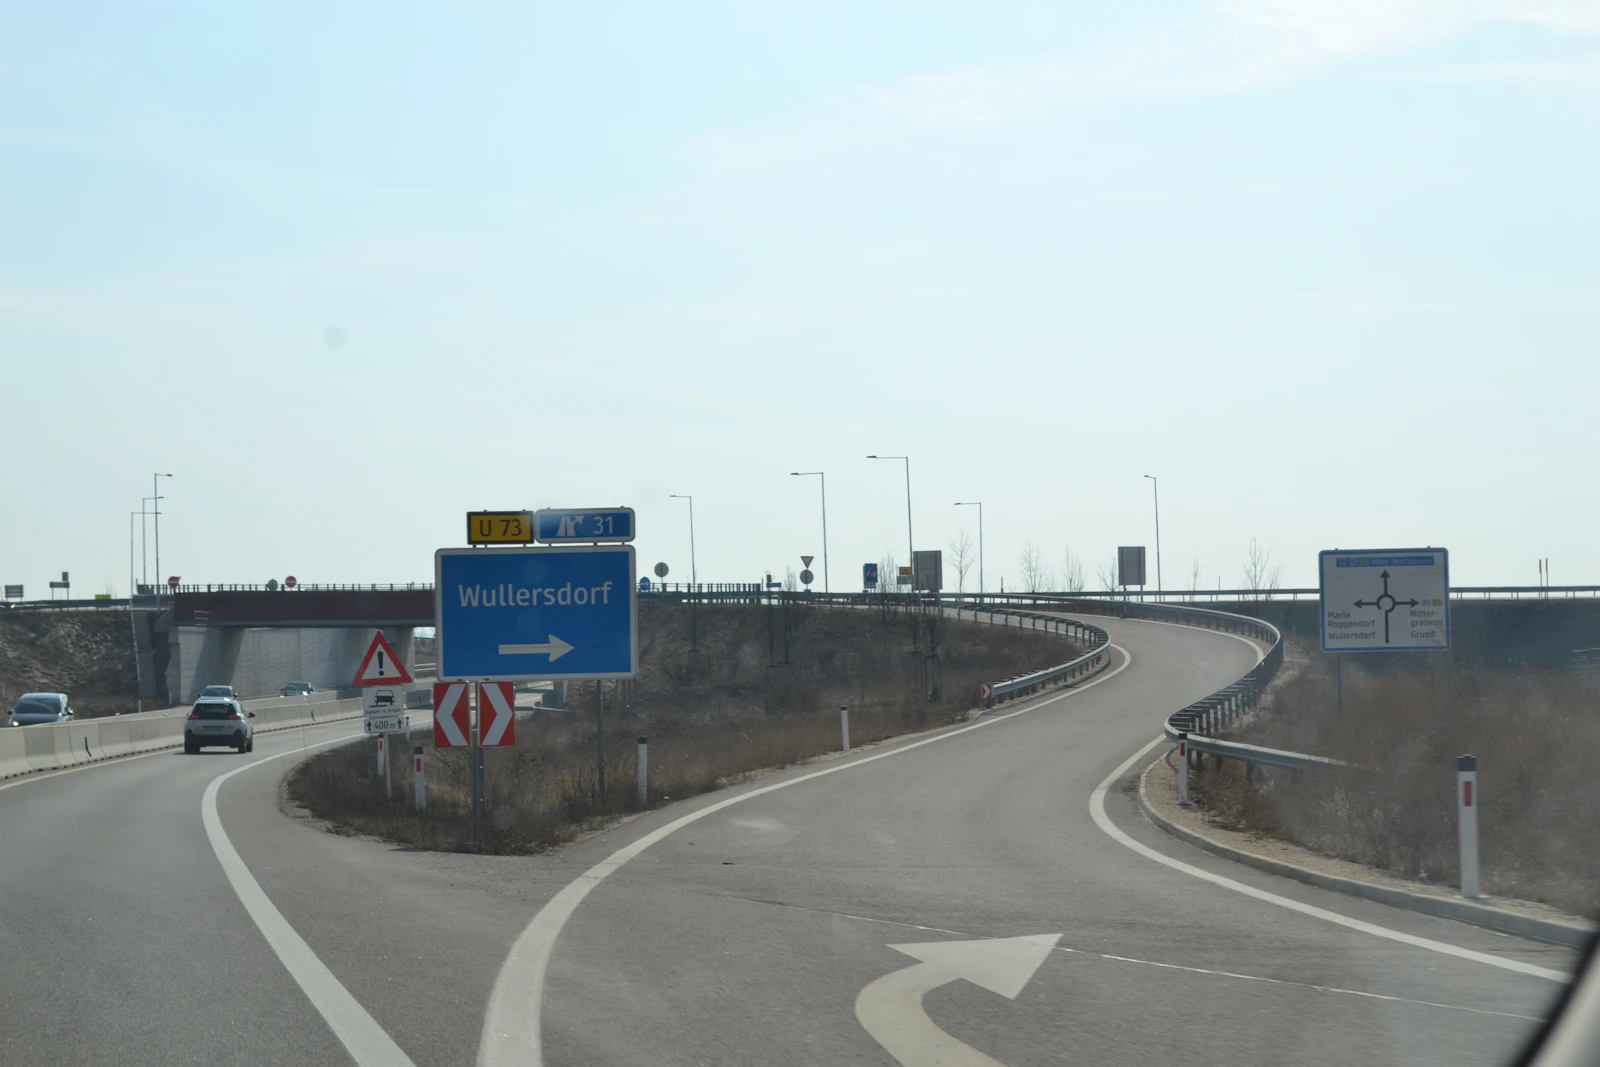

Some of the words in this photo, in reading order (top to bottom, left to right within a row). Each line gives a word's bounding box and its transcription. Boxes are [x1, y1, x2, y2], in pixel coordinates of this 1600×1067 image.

[479, 520, 492, 537] U
[500, 519, 522, 537] 73
[593, 516, 614, 534] 31
[458, 581, 613, 607] Wullersdorf
[1328, 620, 1375, 629] Roggendorf
[1410, 630, 1436, 638] Grund
[374, 720, 388, 730] 400
